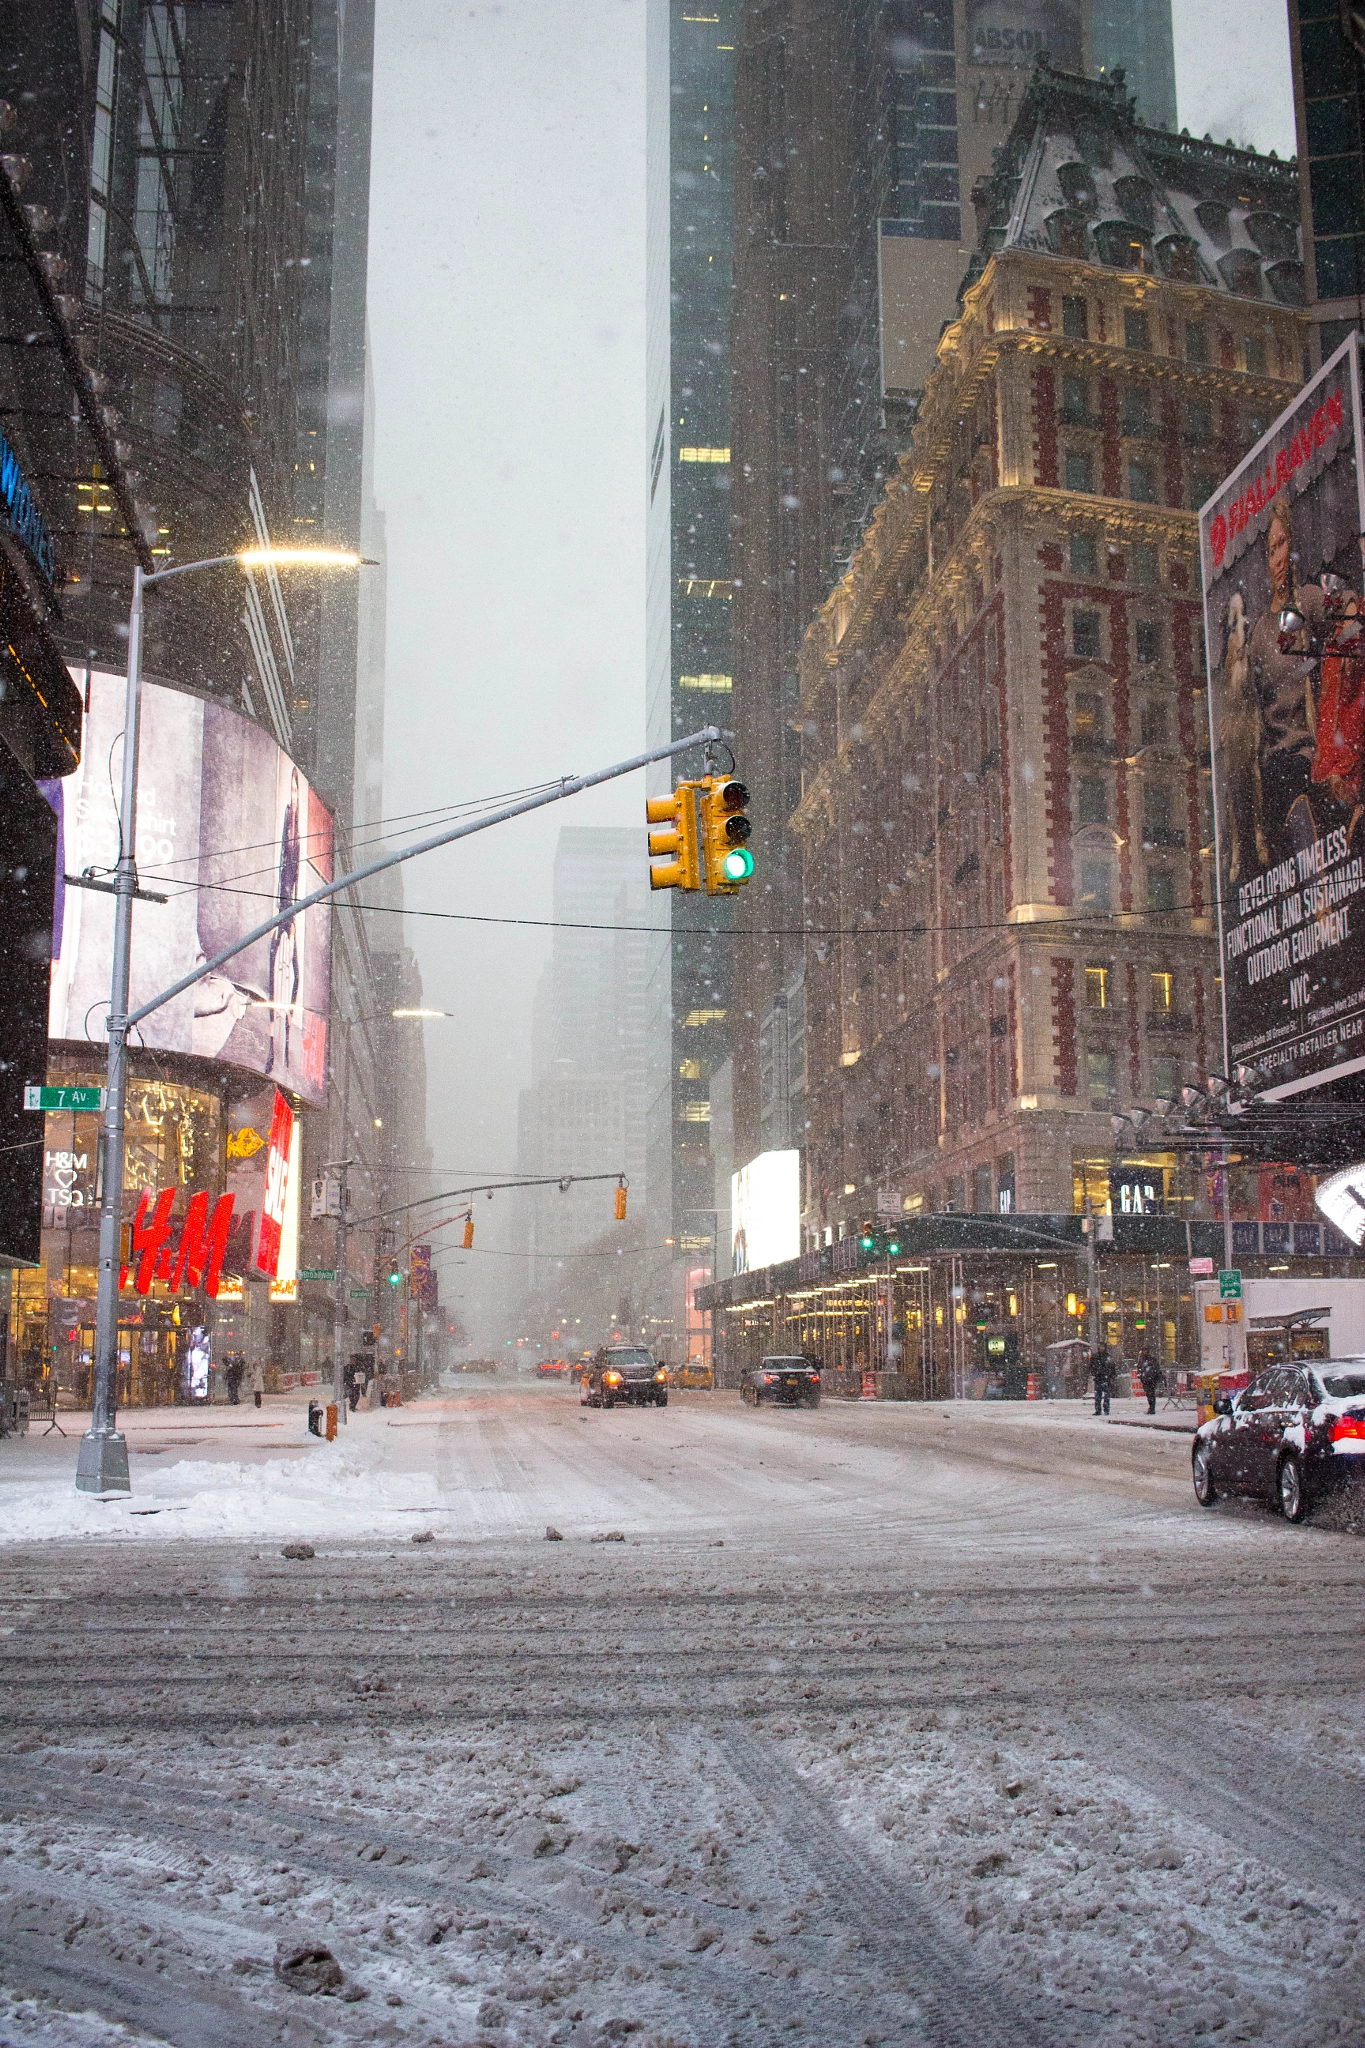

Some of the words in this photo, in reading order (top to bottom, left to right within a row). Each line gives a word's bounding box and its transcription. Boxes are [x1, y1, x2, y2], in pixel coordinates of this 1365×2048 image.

[1238, 857, 1297, 916] DEVELOPING
[1226, 905, 1281, 960] FUNCTIONAL
[1282, 893, 1302, 931] AND
[1247, 937, 1291, 985] OUTDOOR
[1291, 905, 1350, 965] EQUIPMENT
[1289, 972, 1311, 1010] NYC
[1300, 1029, 1339, 1057] RETAILER
[1340, 1019, 1364, 1041] NEAR
[57, 1090, 66, 1107] 7
[46, 1151, 88, 1170] H&M
[48, 1188, 84, 1207] TSQ
[1120, 1184, 1155, 1214] GAP
[118, 1186, 235, 1299] H&M
[302, 1270, 334, 1280] Broadway
